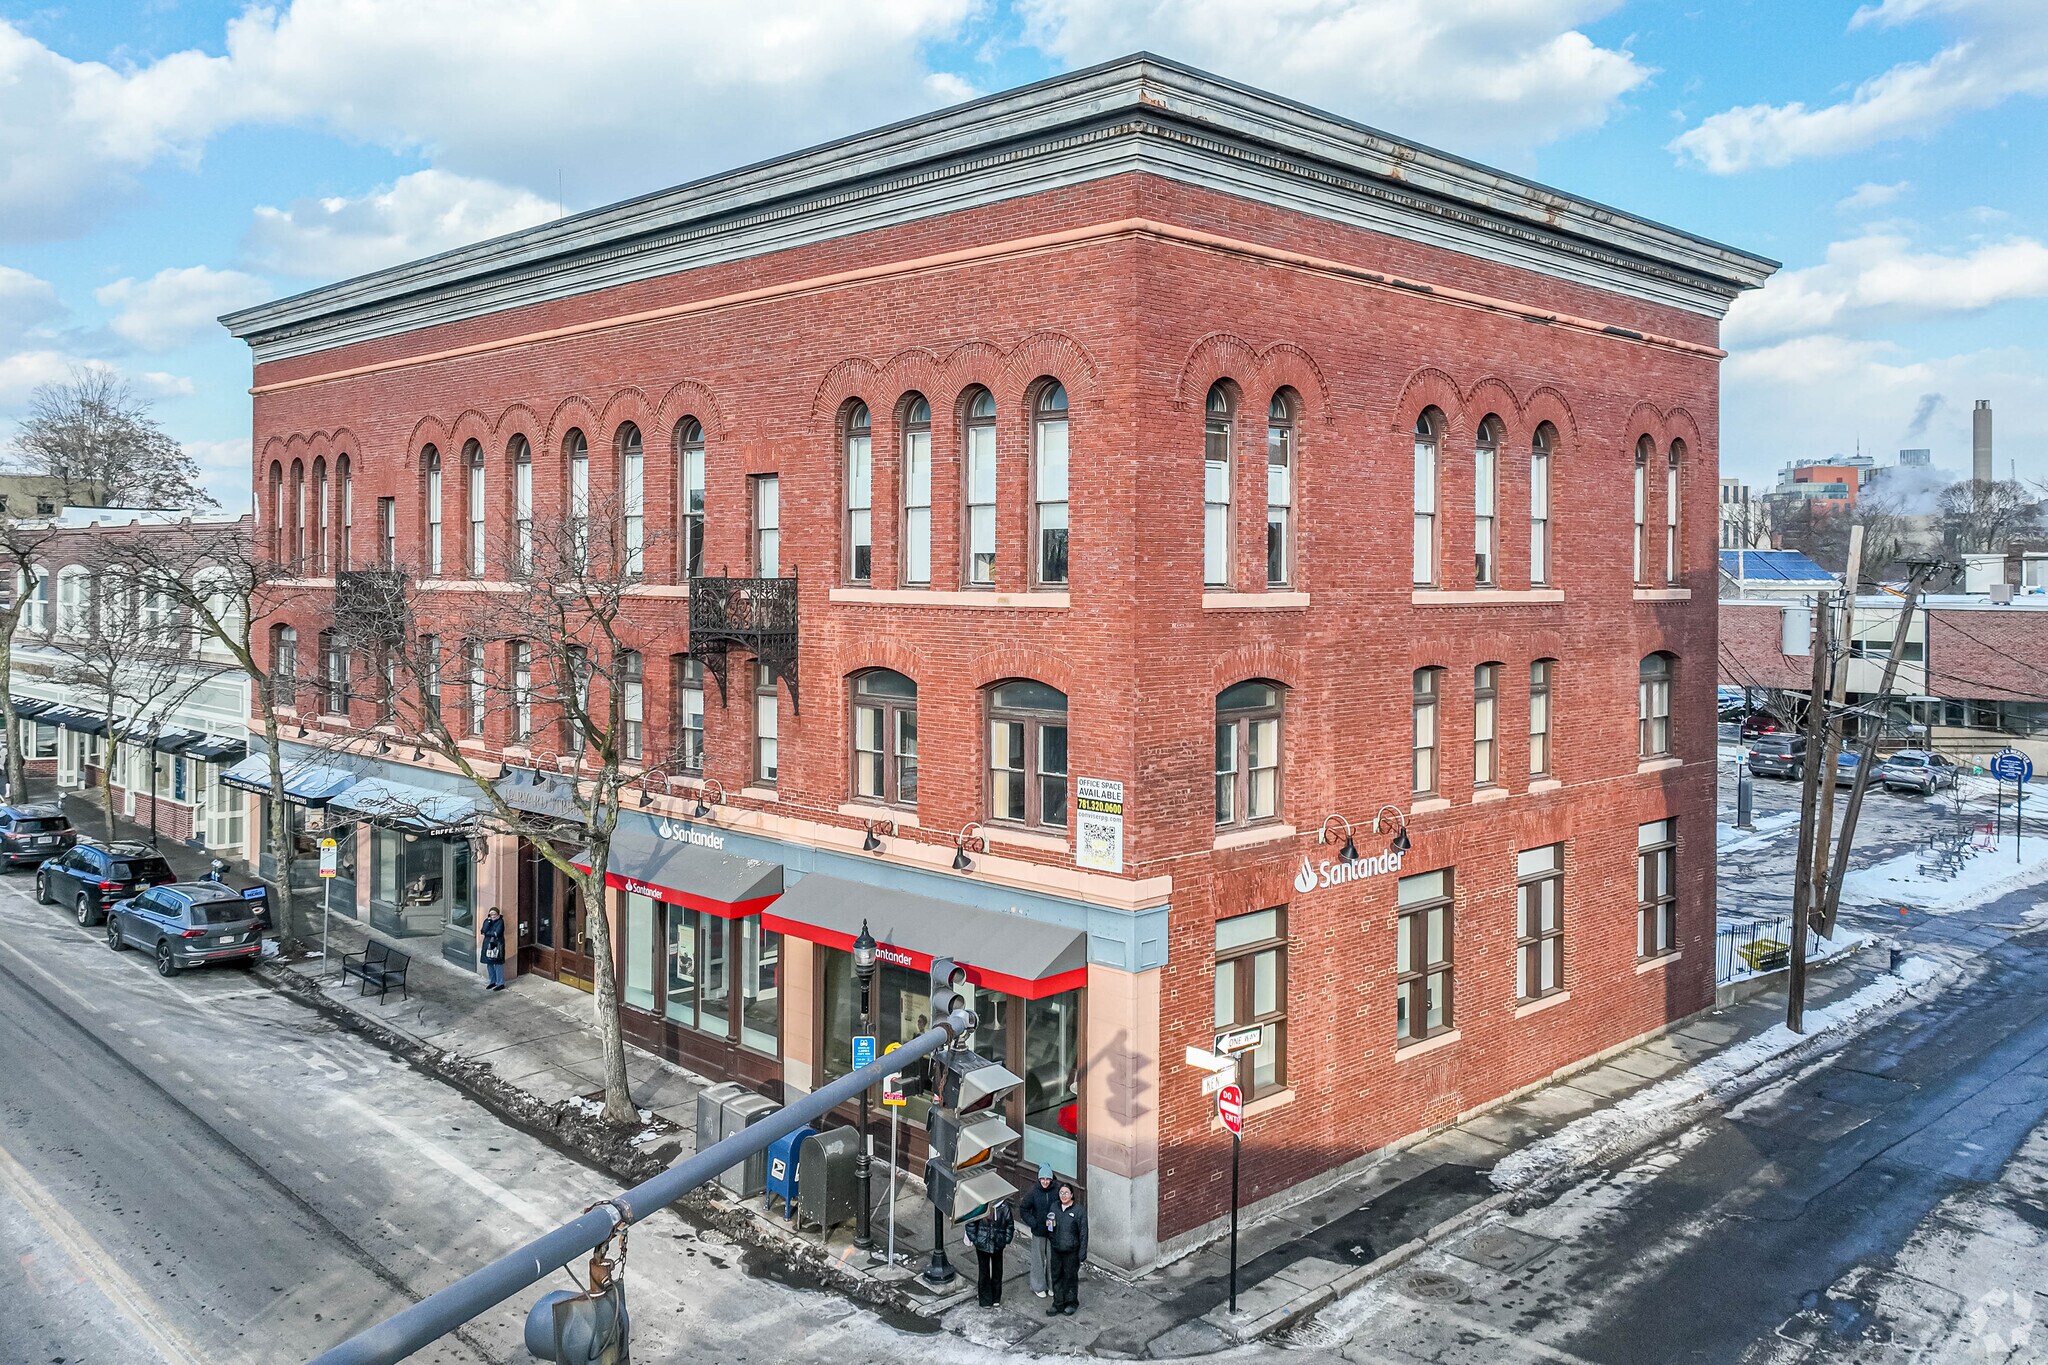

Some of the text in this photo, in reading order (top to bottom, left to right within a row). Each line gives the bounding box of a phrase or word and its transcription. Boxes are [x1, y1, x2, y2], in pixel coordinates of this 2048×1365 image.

[1079, 779, 1121, 791] OFFICE SPACE
[1078, 787, 1122, 801] AVAILABLE
[672, 823, 725, 850] Santander
[1319, 848, 1405, 888] Santander
[632, 882, 663, 899] Santander
[875, 948, 913, 966] antander
[1228, 1036, 1242, 1048] ONE
[1222, 1090, 1232, 1101] DO
